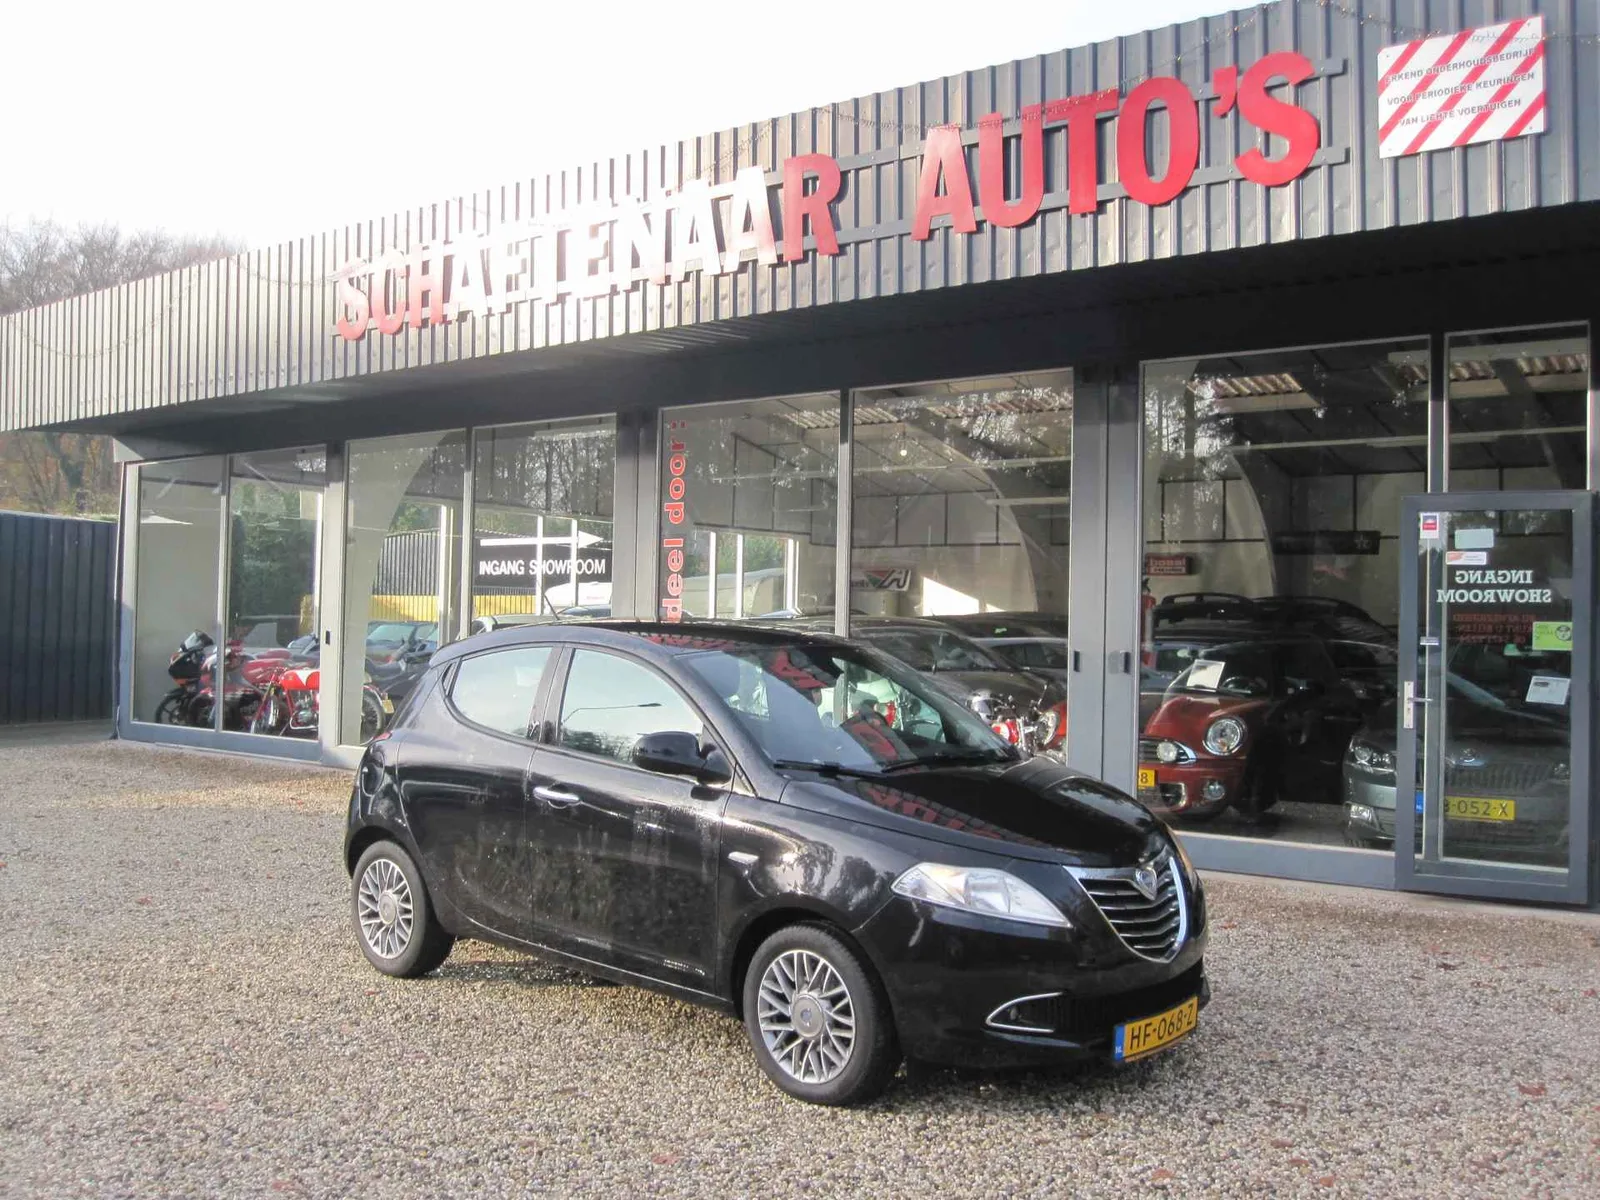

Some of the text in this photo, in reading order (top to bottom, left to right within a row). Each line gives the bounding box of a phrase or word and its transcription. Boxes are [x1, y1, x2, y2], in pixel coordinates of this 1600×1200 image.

[1425, 47, 1537, 75] ONDERHOUDSBEDRIJF
[1387, 71, 1535, 106] VOOR PERIODIEKE KEURINGEN
[1399, 98, 1522, 127] VAN LICHTE VOERTUIGEN
[910, 51, 1321, 241] AUTO'S
[478, 559, 525, 576] INGANG
[1130, 1003, 1193, 1050] HF-068-Z
